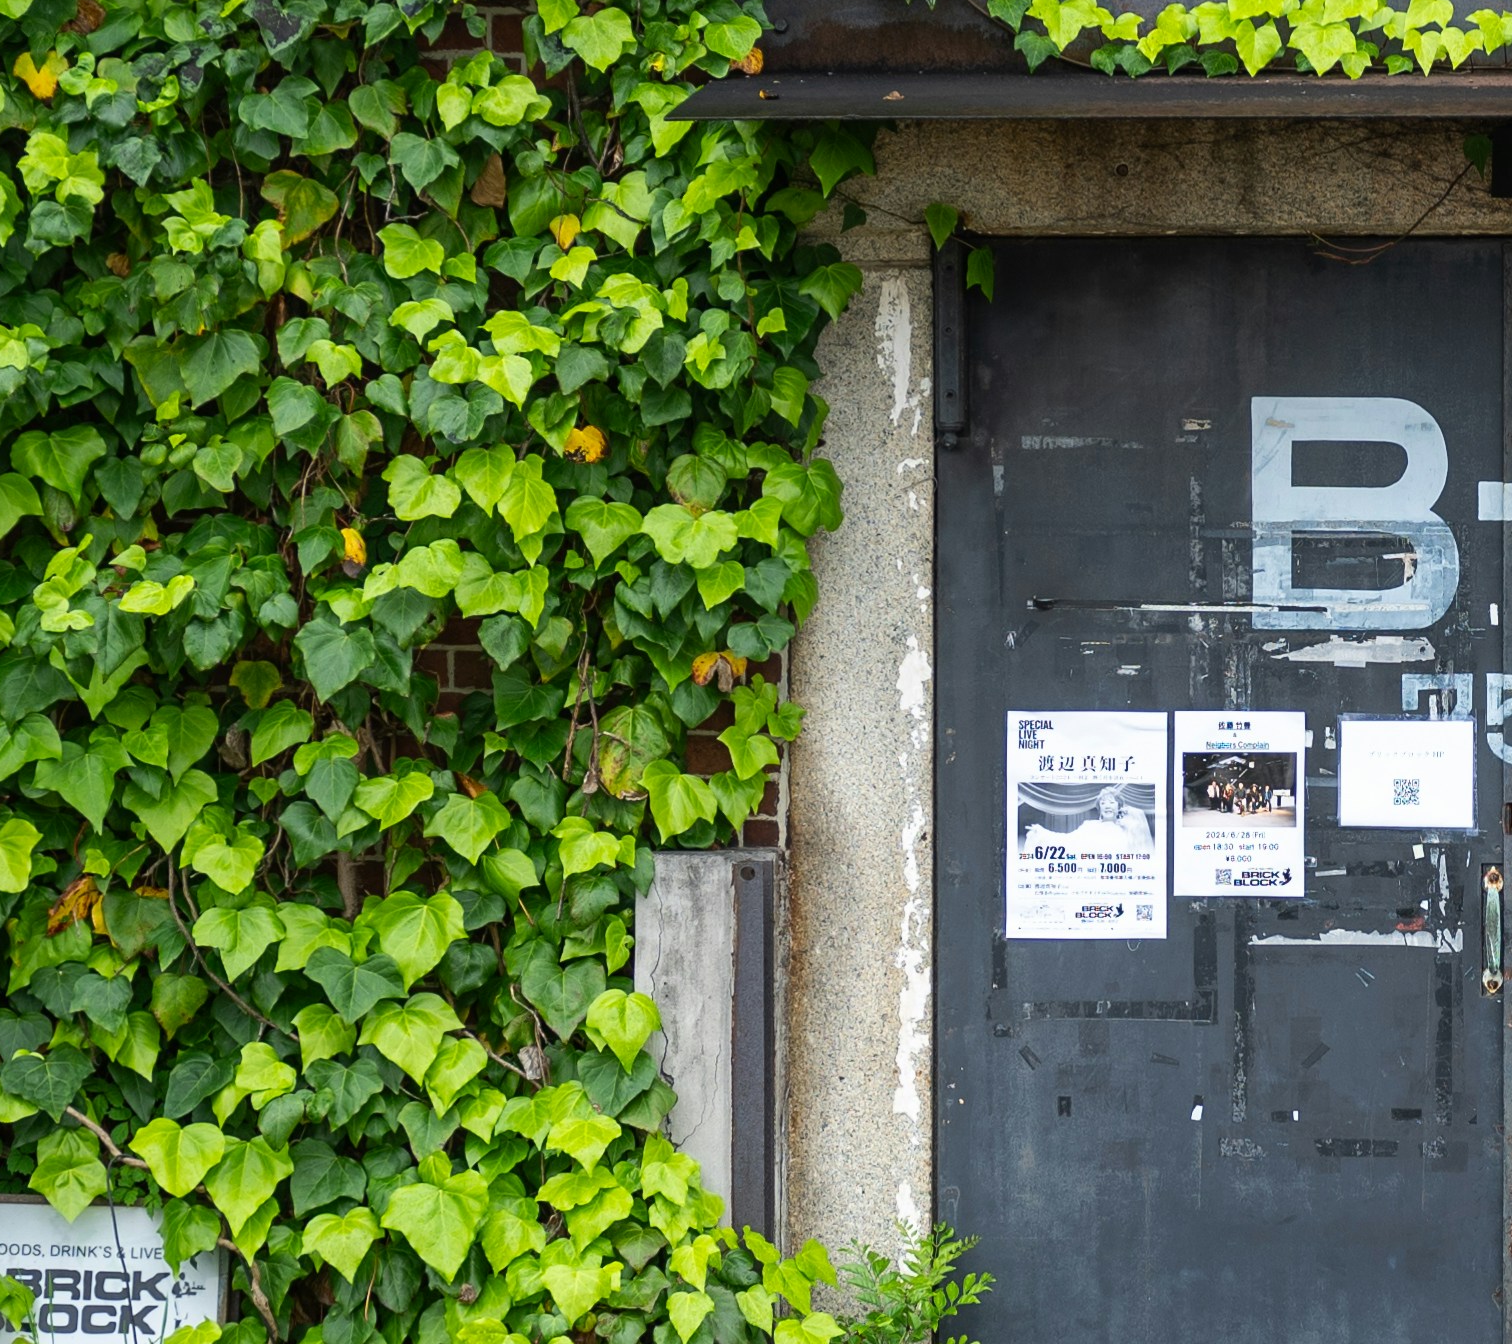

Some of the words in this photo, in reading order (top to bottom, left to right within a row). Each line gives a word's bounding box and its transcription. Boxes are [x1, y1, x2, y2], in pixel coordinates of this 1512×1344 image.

[1019, 720, 1054, 729] SPECIAL
[1019, 730, 1037, 739] LIVE
[1019, 740, 1045, 749] NIGHT
[1035, 846, 1066, 860] 6/22
[1234, 879, 1278, 887] BLOCK
[131, 1247, 163, 1260] LIVE
